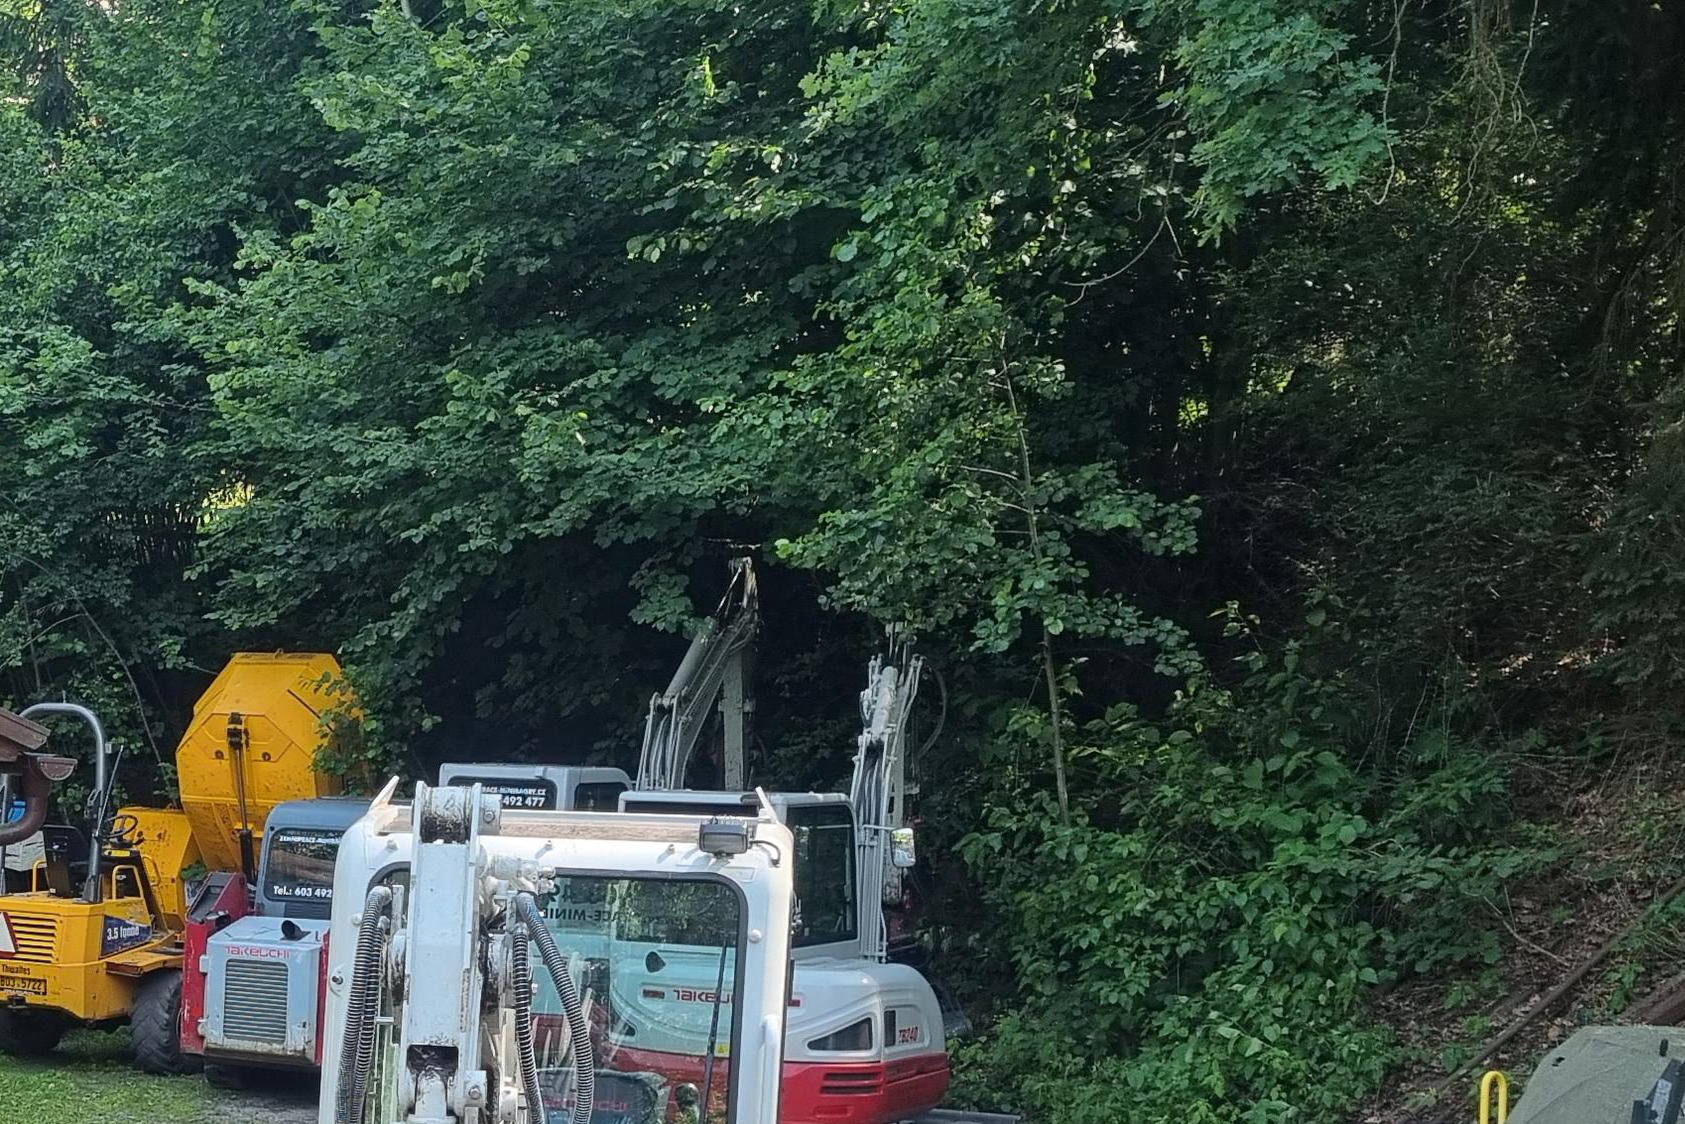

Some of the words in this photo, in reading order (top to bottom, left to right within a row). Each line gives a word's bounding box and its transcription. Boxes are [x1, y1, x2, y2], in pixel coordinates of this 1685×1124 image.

[502, 796, 523, 806] 492
[525, 797, 545, 807] 477
[294, 887, 312, 897] 603
[314, 888, 332, 898] 492
[106, 927, 119, 941] 3.5
[1, 963, 31, 976] Thwaites
